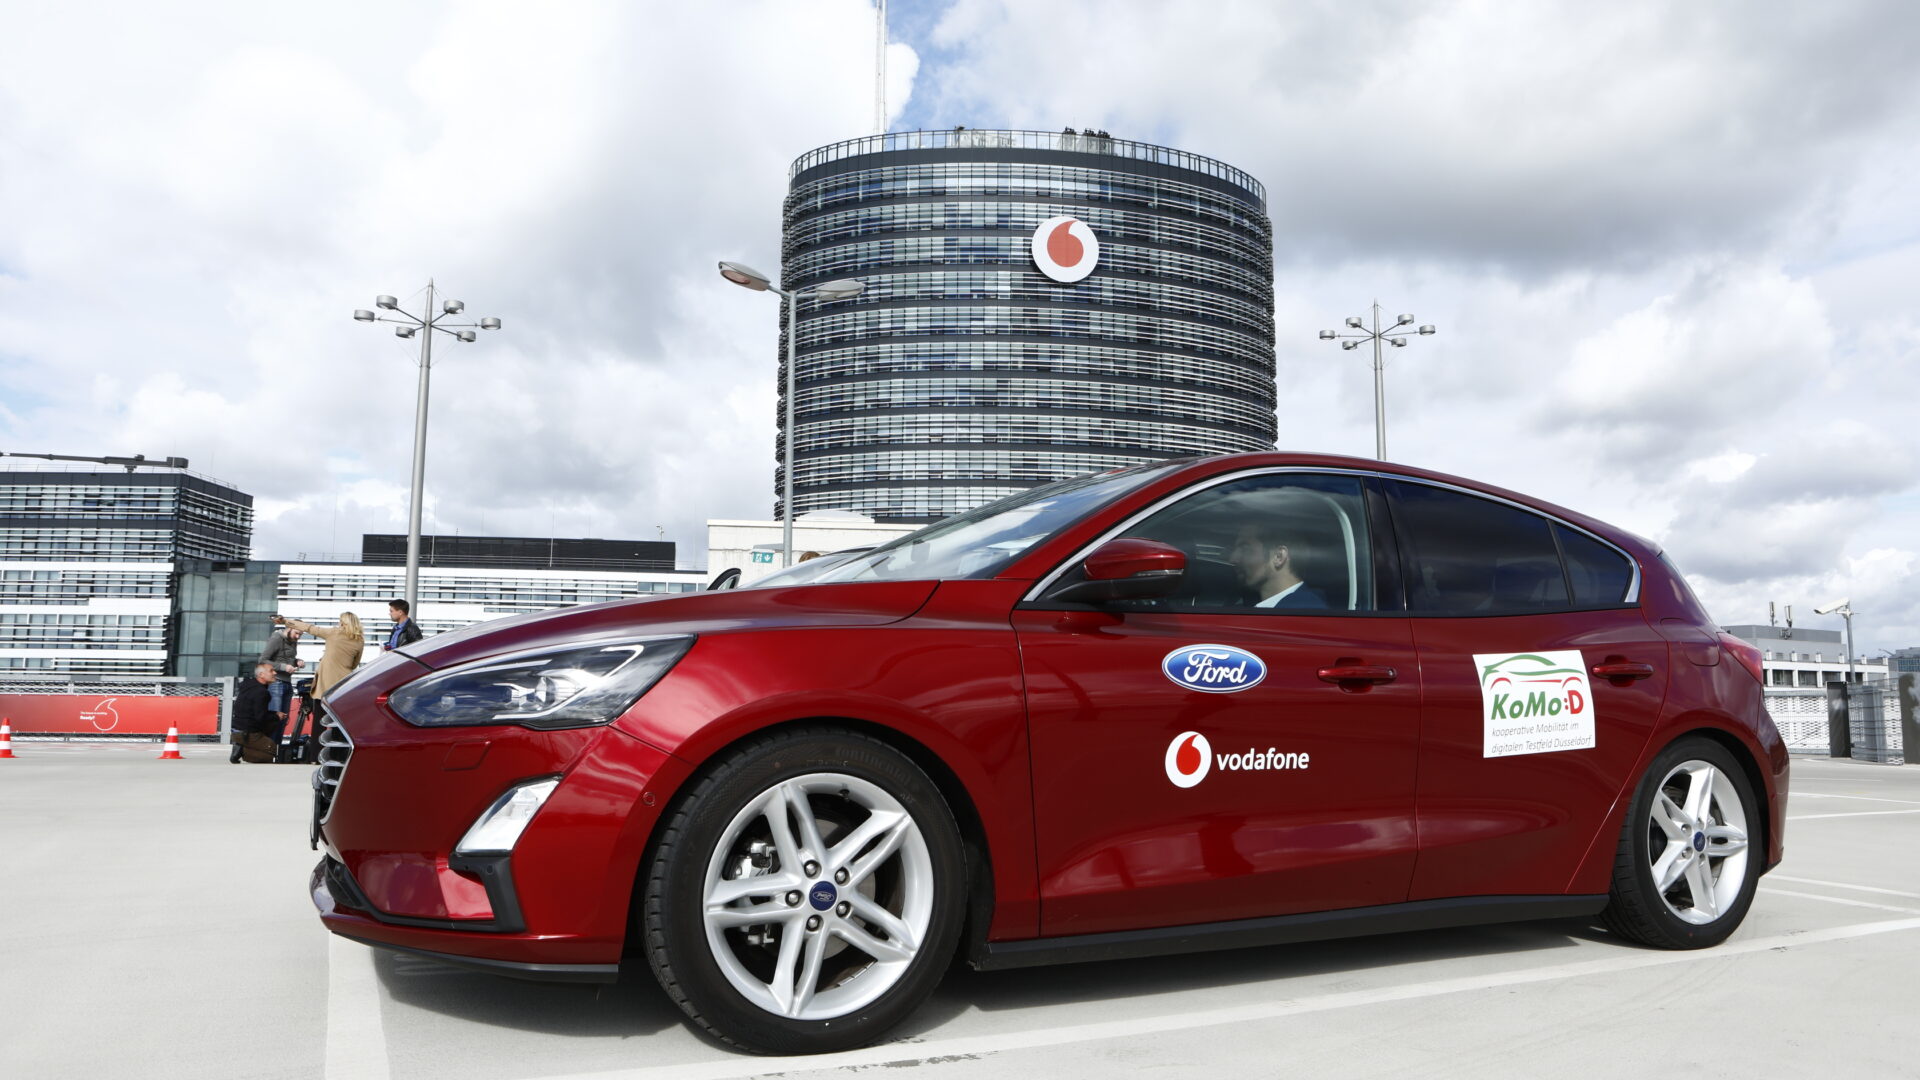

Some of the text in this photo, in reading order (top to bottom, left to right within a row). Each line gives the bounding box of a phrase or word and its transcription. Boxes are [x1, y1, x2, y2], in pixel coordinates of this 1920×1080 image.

[1184, 652, 1247, 683] Ford
[1491, 690, 1584, 720] KoMo:D
[1492, 727, 1535, 737] kooperative
[1570, 721, 1579, 730] im
[1216, 747, 1310, 770] vodafone
[1491, 742, 1524, 755] digitalen
[1526, 739, 1553, 751] Testfeld
